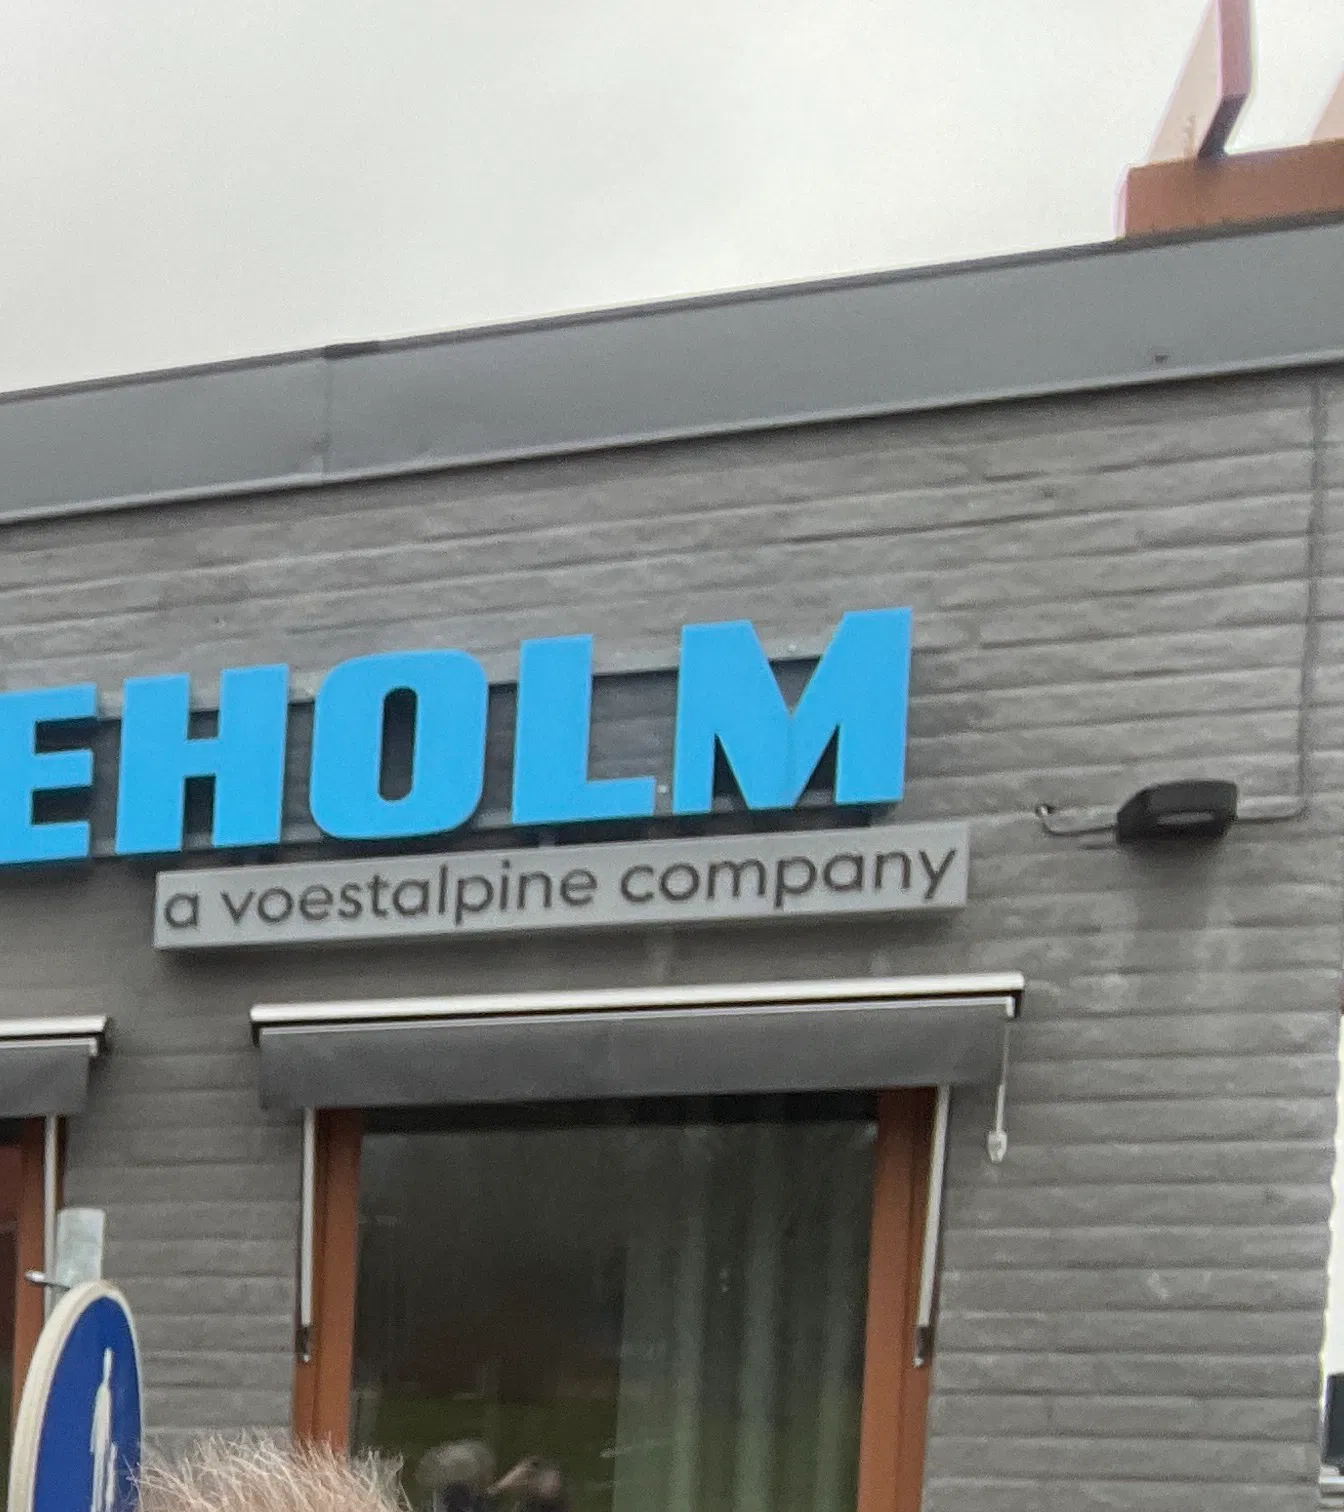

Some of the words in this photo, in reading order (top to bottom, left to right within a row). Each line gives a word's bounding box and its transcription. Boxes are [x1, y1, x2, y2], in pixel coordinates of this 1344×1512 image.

[163, 891, 201, 929] a
[220, 859, 599, 927] voestalpine
[620, 848, 957, 910] company
